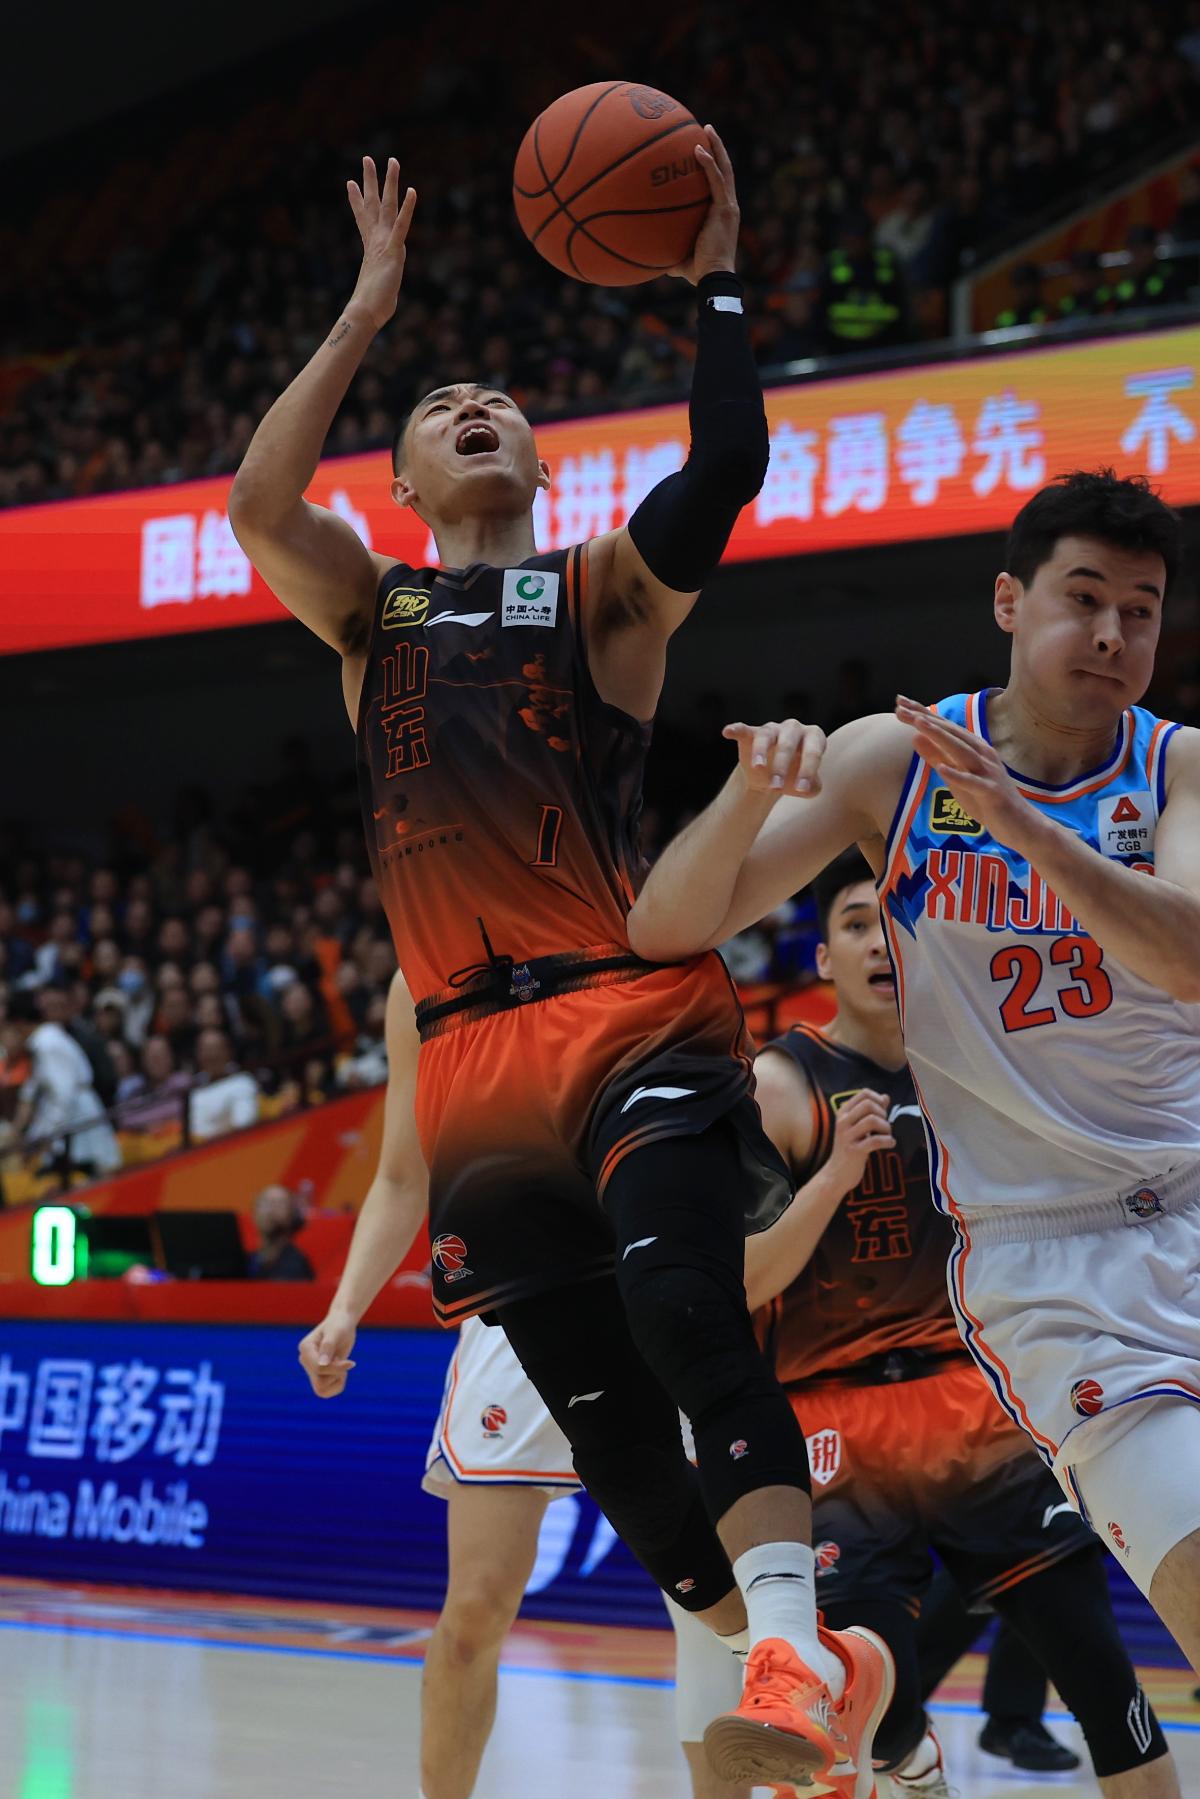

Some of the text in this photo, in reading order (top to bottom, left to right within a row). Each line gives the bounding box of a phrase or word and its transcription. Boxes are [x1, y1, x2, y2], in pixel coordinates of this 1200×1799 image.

[1120, 366, 1196, 475] 不
[505, 604, 552, 615] 中国人寿
[505, 614, 550, 622] CHINA LIFE
[381, 641, 431, 779] 山东
[1108, 828, 1148, 841] 广发银行
[1116, 841, 1142, 852] CGB
[925, 847, 1155, 933] XINJI
[990, 936, 1114, 1034] 23
[33, 1206, 76, 1287] 0
[0, 1470, 209, 1548] hina Mobile
